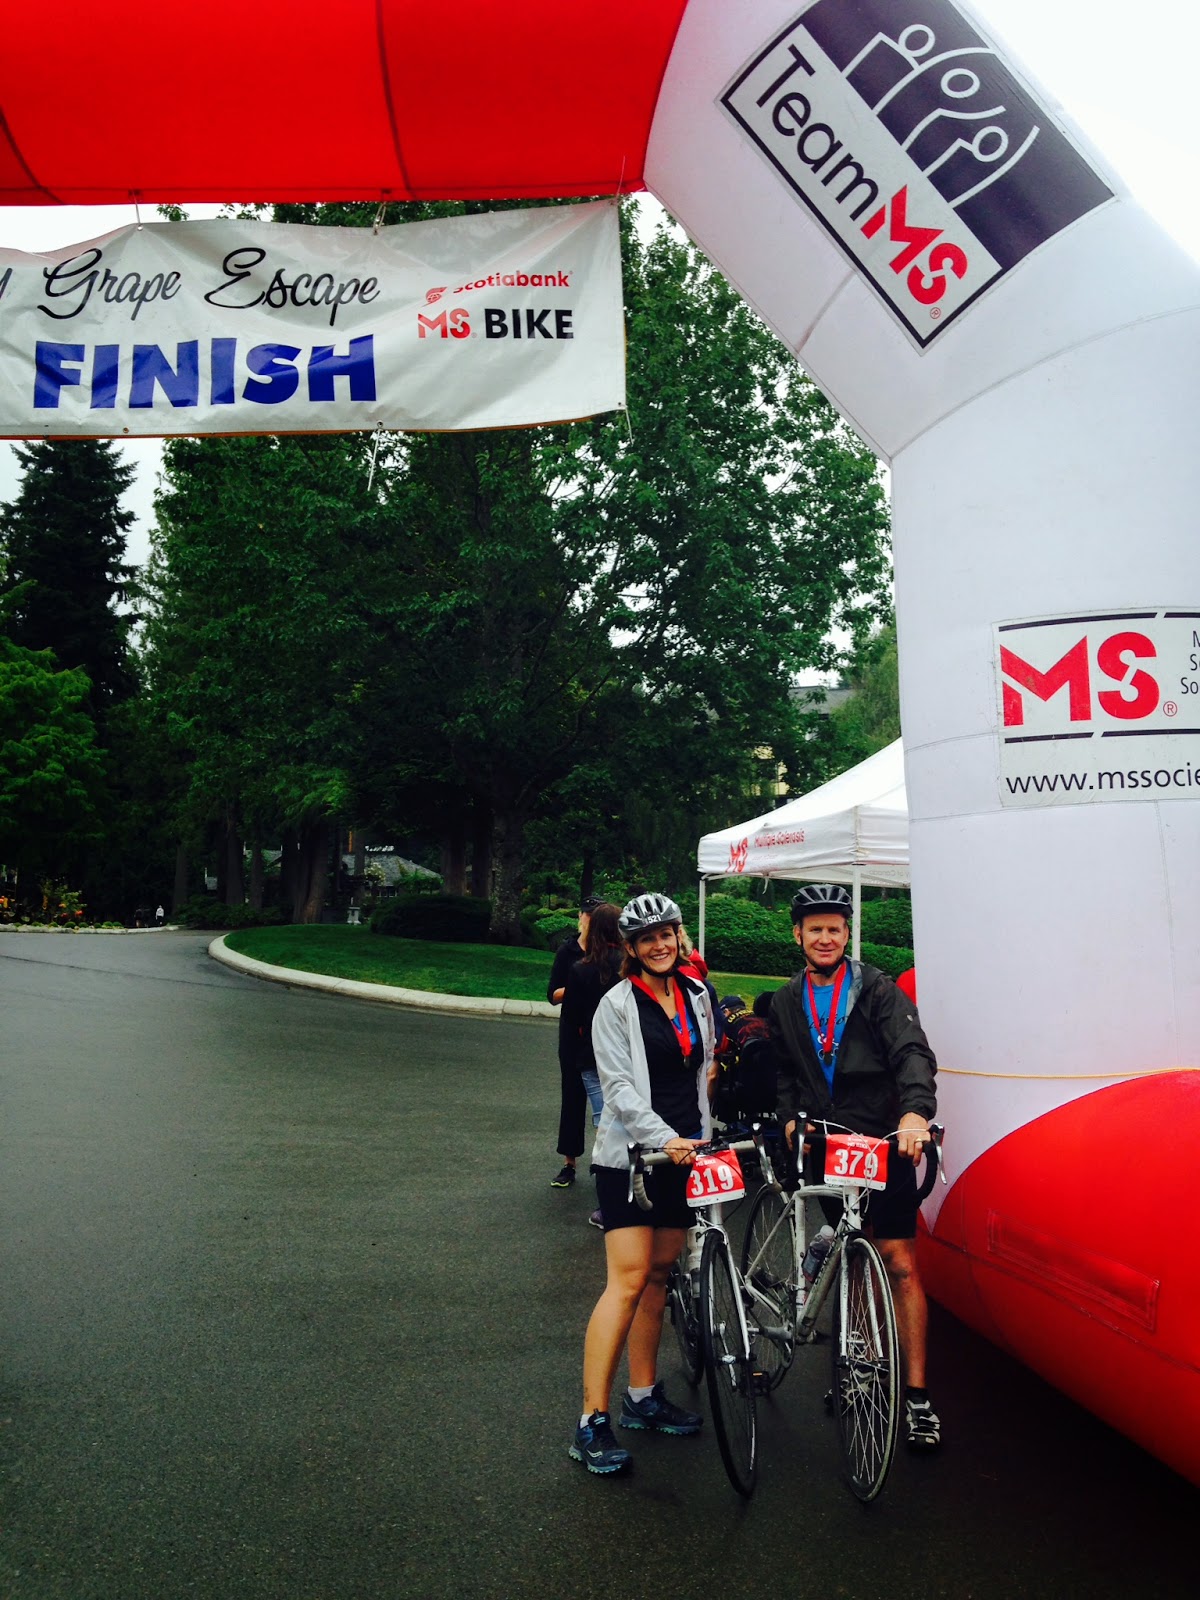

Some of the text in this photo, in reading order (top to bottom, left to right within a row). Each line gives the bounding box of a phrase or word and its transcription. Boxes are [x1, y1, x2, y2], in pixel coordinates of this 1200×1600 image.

[37, 248, 182, 320] Grape
[204, 247, 381, 326] Escape
[417, 308, 574, 339] MS BIKE
[33, 334, 376, 409] FINISH
[1000, 632, 1160, 726] MS
[690, 1165, 734, 1196] 319
[834, 1148, 879, 1179] 379
